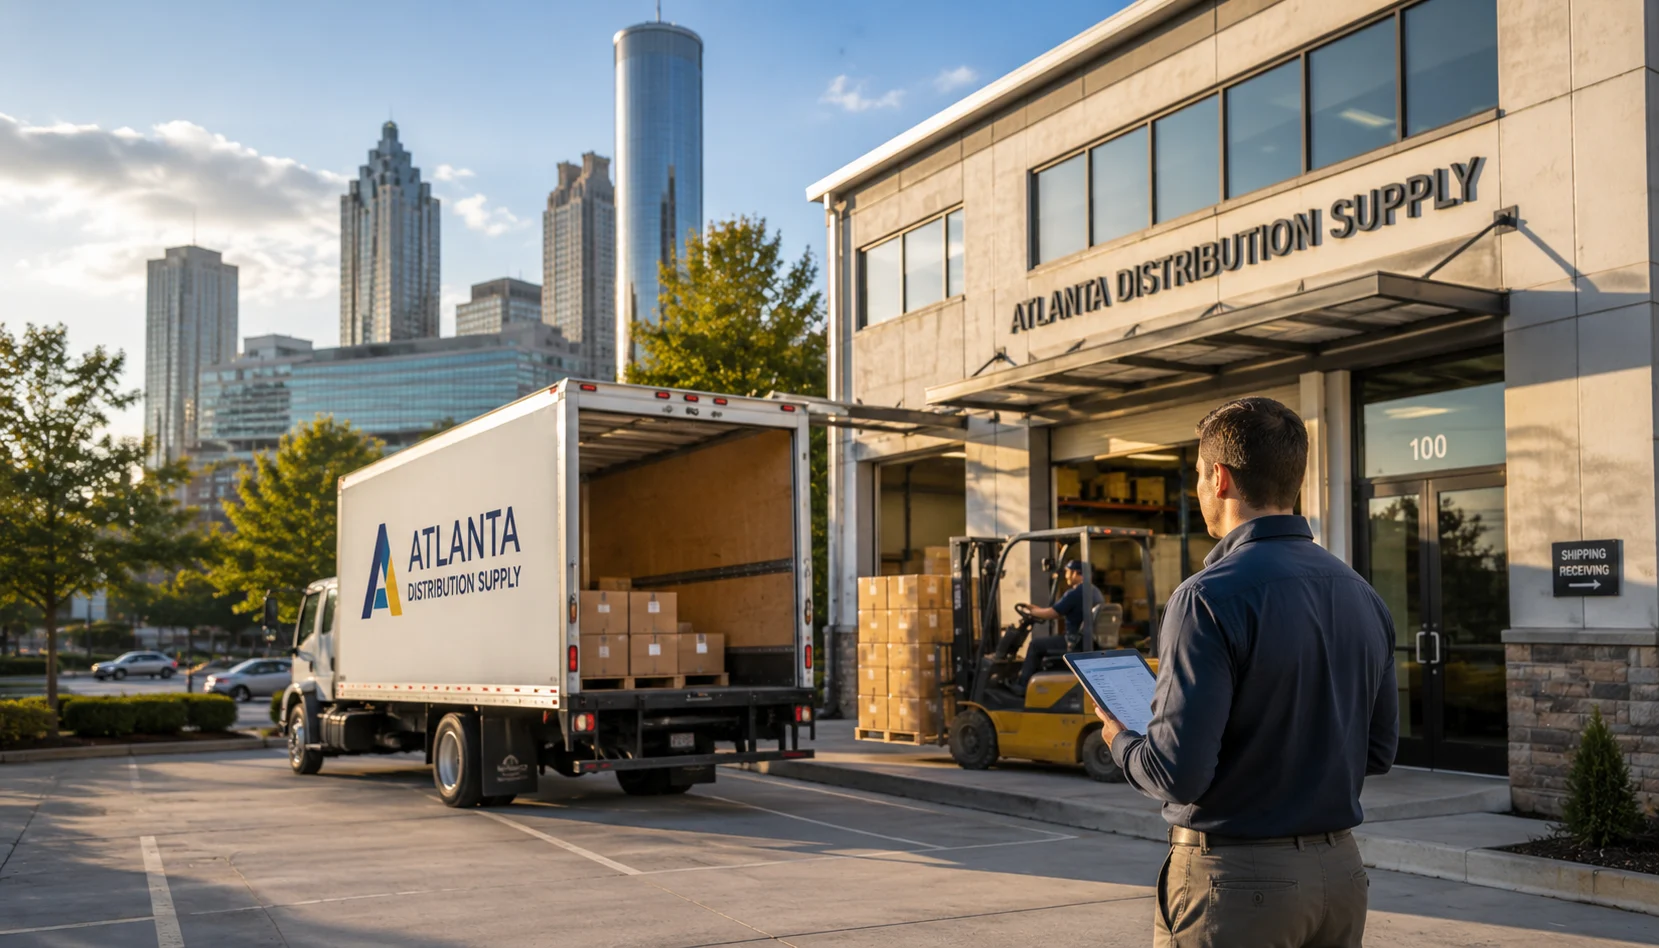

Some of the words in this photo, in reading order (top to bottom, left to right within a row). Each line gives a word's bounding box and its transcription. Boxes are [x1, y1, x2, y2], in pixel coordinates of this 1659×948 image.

[1010, 276, 1112, 334] ATLANTA
[1116, 208, 1322, 302] DISTRIBUTION
[1329, 156, 1486, 239] SUPPLY
[1409, 434, 1447, 461] 100
[408, 506, 521, 572] ATLANTA
[1561, 548, 1607, 561] SHIPPING
[408, 572, 475, 601] DISTRIBUTION
[478, 565, 522, 592] SUPPLY
[1559, 564, 1610, 577] RECEIVING
